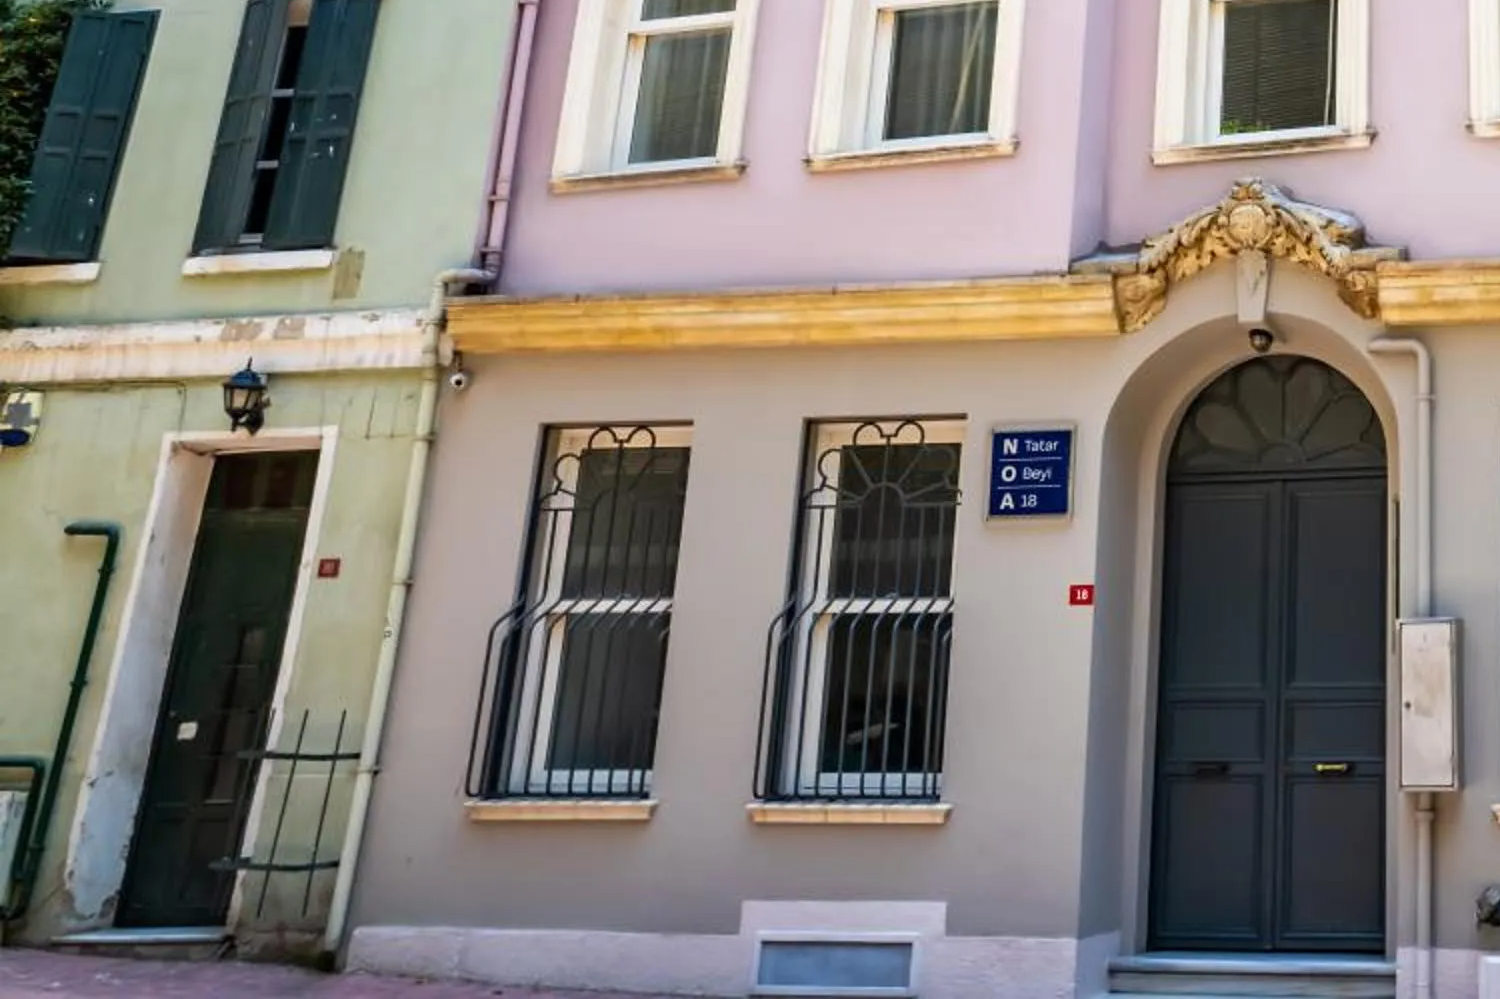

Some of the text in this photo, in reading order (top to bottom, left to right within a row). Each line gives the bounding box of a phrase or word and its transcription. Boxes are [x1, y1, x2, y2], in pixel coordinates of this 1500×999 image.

[1003, 438, 1059, 455] N Tatar
[1001, 465, 1017, 482] O
[999, 492, 1037, 510] A 18
